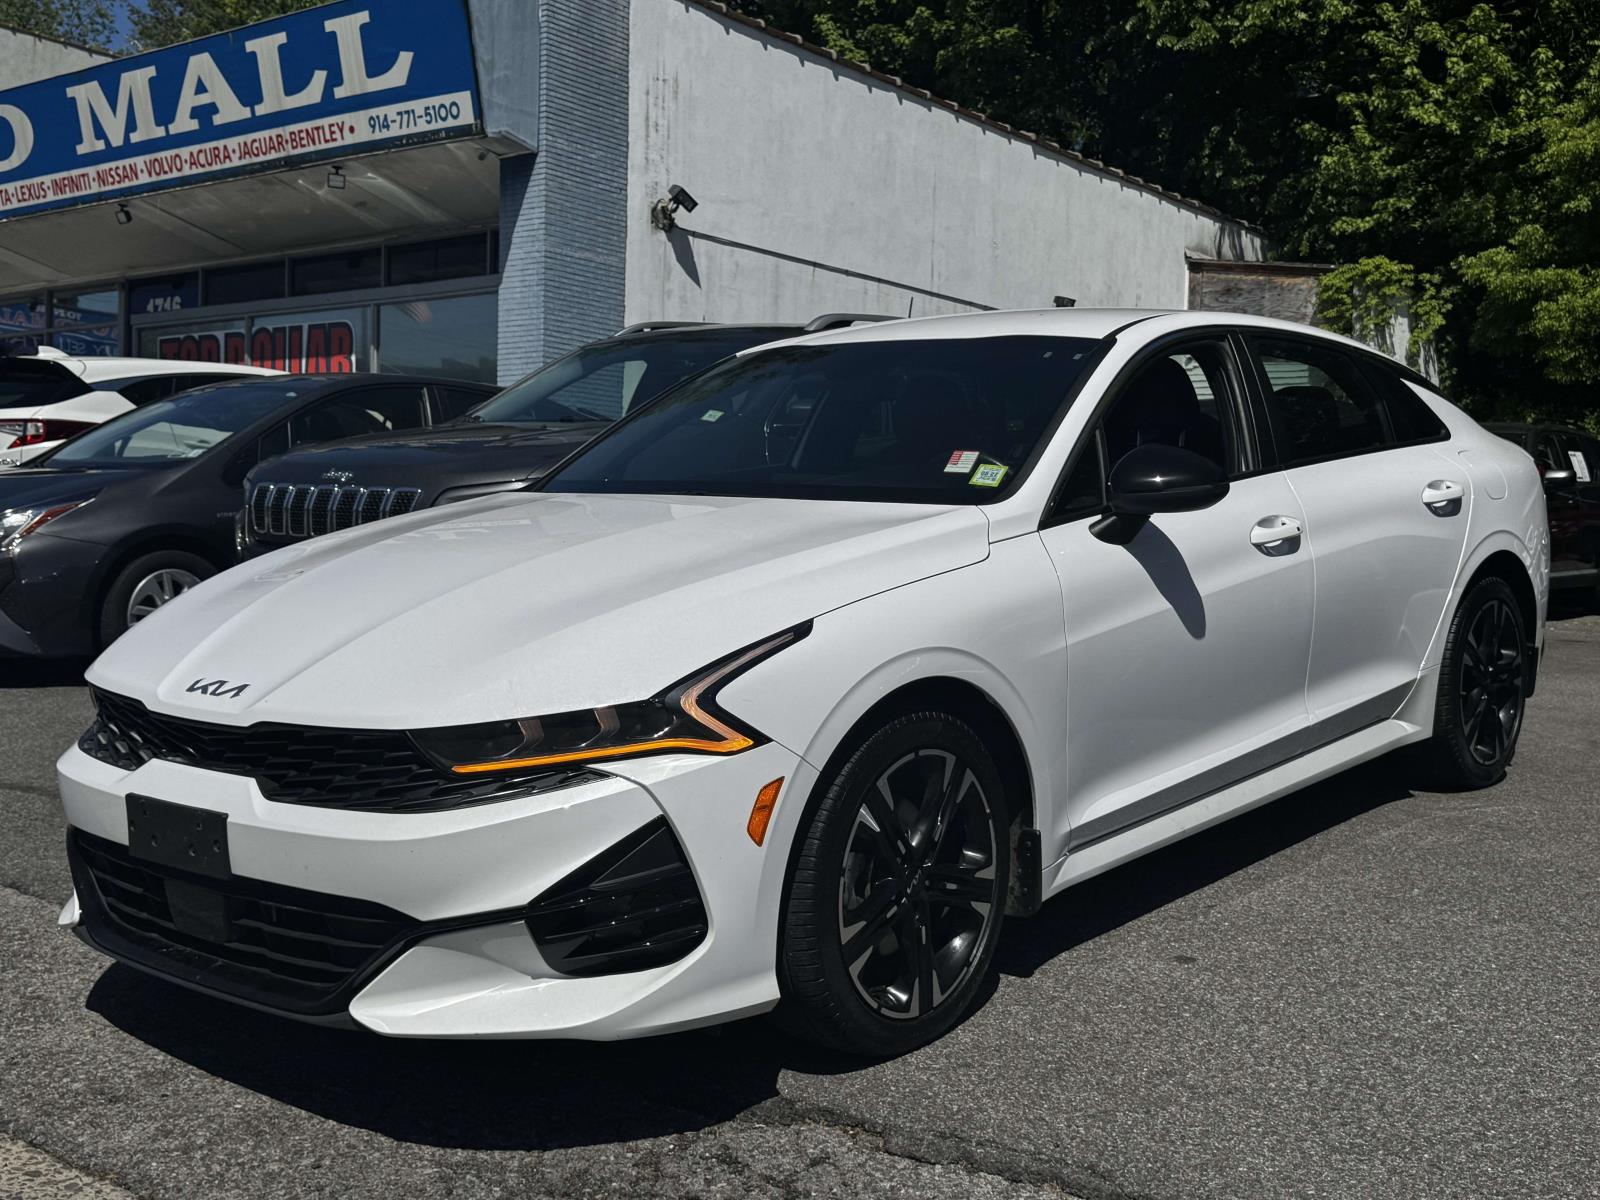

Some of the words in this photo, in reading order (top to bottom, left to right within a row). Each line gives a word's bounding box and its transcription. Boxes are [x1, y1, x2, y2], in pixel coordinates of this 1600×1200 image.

[66, 10, 414, 155] MALL
[15, 181, 48, 203] LEXUS
[52, 173, 91, 197] INFINITI
[98, 163, 139, 187] NISSAN
[146, 153, 183, 178] VOLVO
[189, 145, 232, 170] ACURA
[237, 135, 286, 160] JAGUAR
[289, 121, 345, 150] BENTLEY
[368, 101, 460, 134] 914-771-5100
